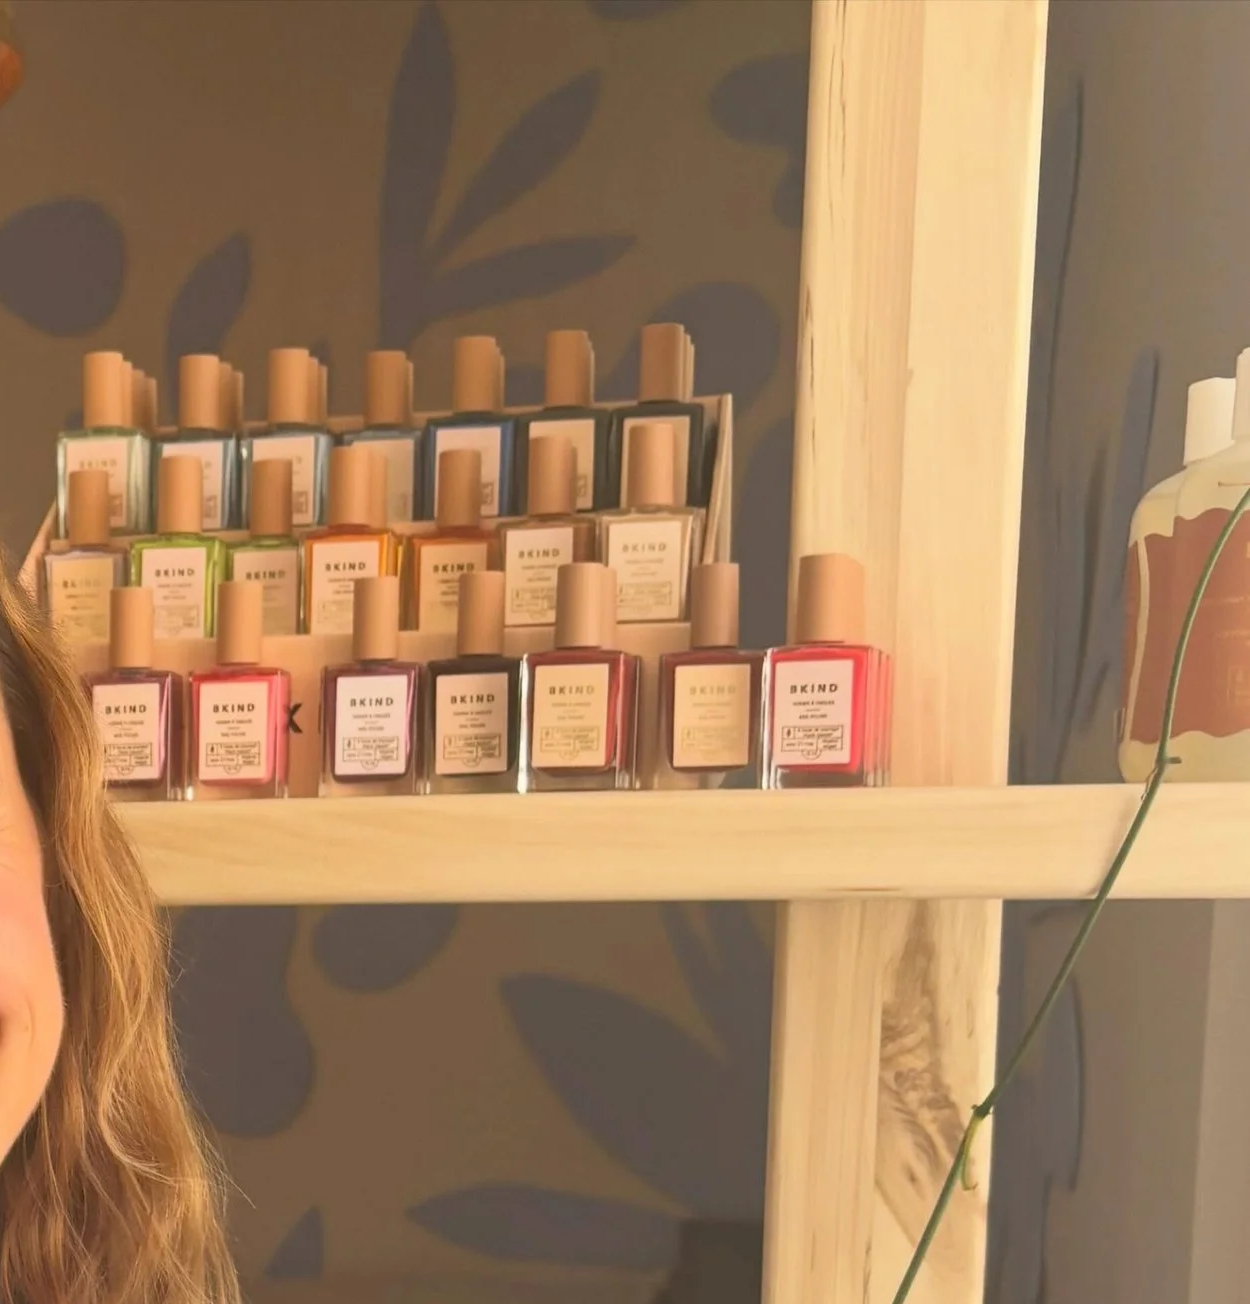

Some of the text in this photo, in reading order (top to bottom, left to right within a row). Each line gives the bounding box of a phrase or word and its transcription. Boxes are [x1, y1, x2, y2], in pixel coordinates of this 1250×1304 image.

[622, 542, 667, 552] BKIND
[518, 548, 560, 559] BKIND
[325, 562, 367, 572] BKIND
[433, 563, 475, 573] BKIND
[154, 568, 195, 578] BKIND
[245, 570, 286, 580] BKIND
[549, 685, 595, 696] BKIND
[789, 683, 838, 694] BKIND
[350, 697, 394, 708] BKIND
[450, 693, 495, 705] BKIND
[105, 704, 147, 715] BKIND
[213, 703, 255, 713] BKIND
